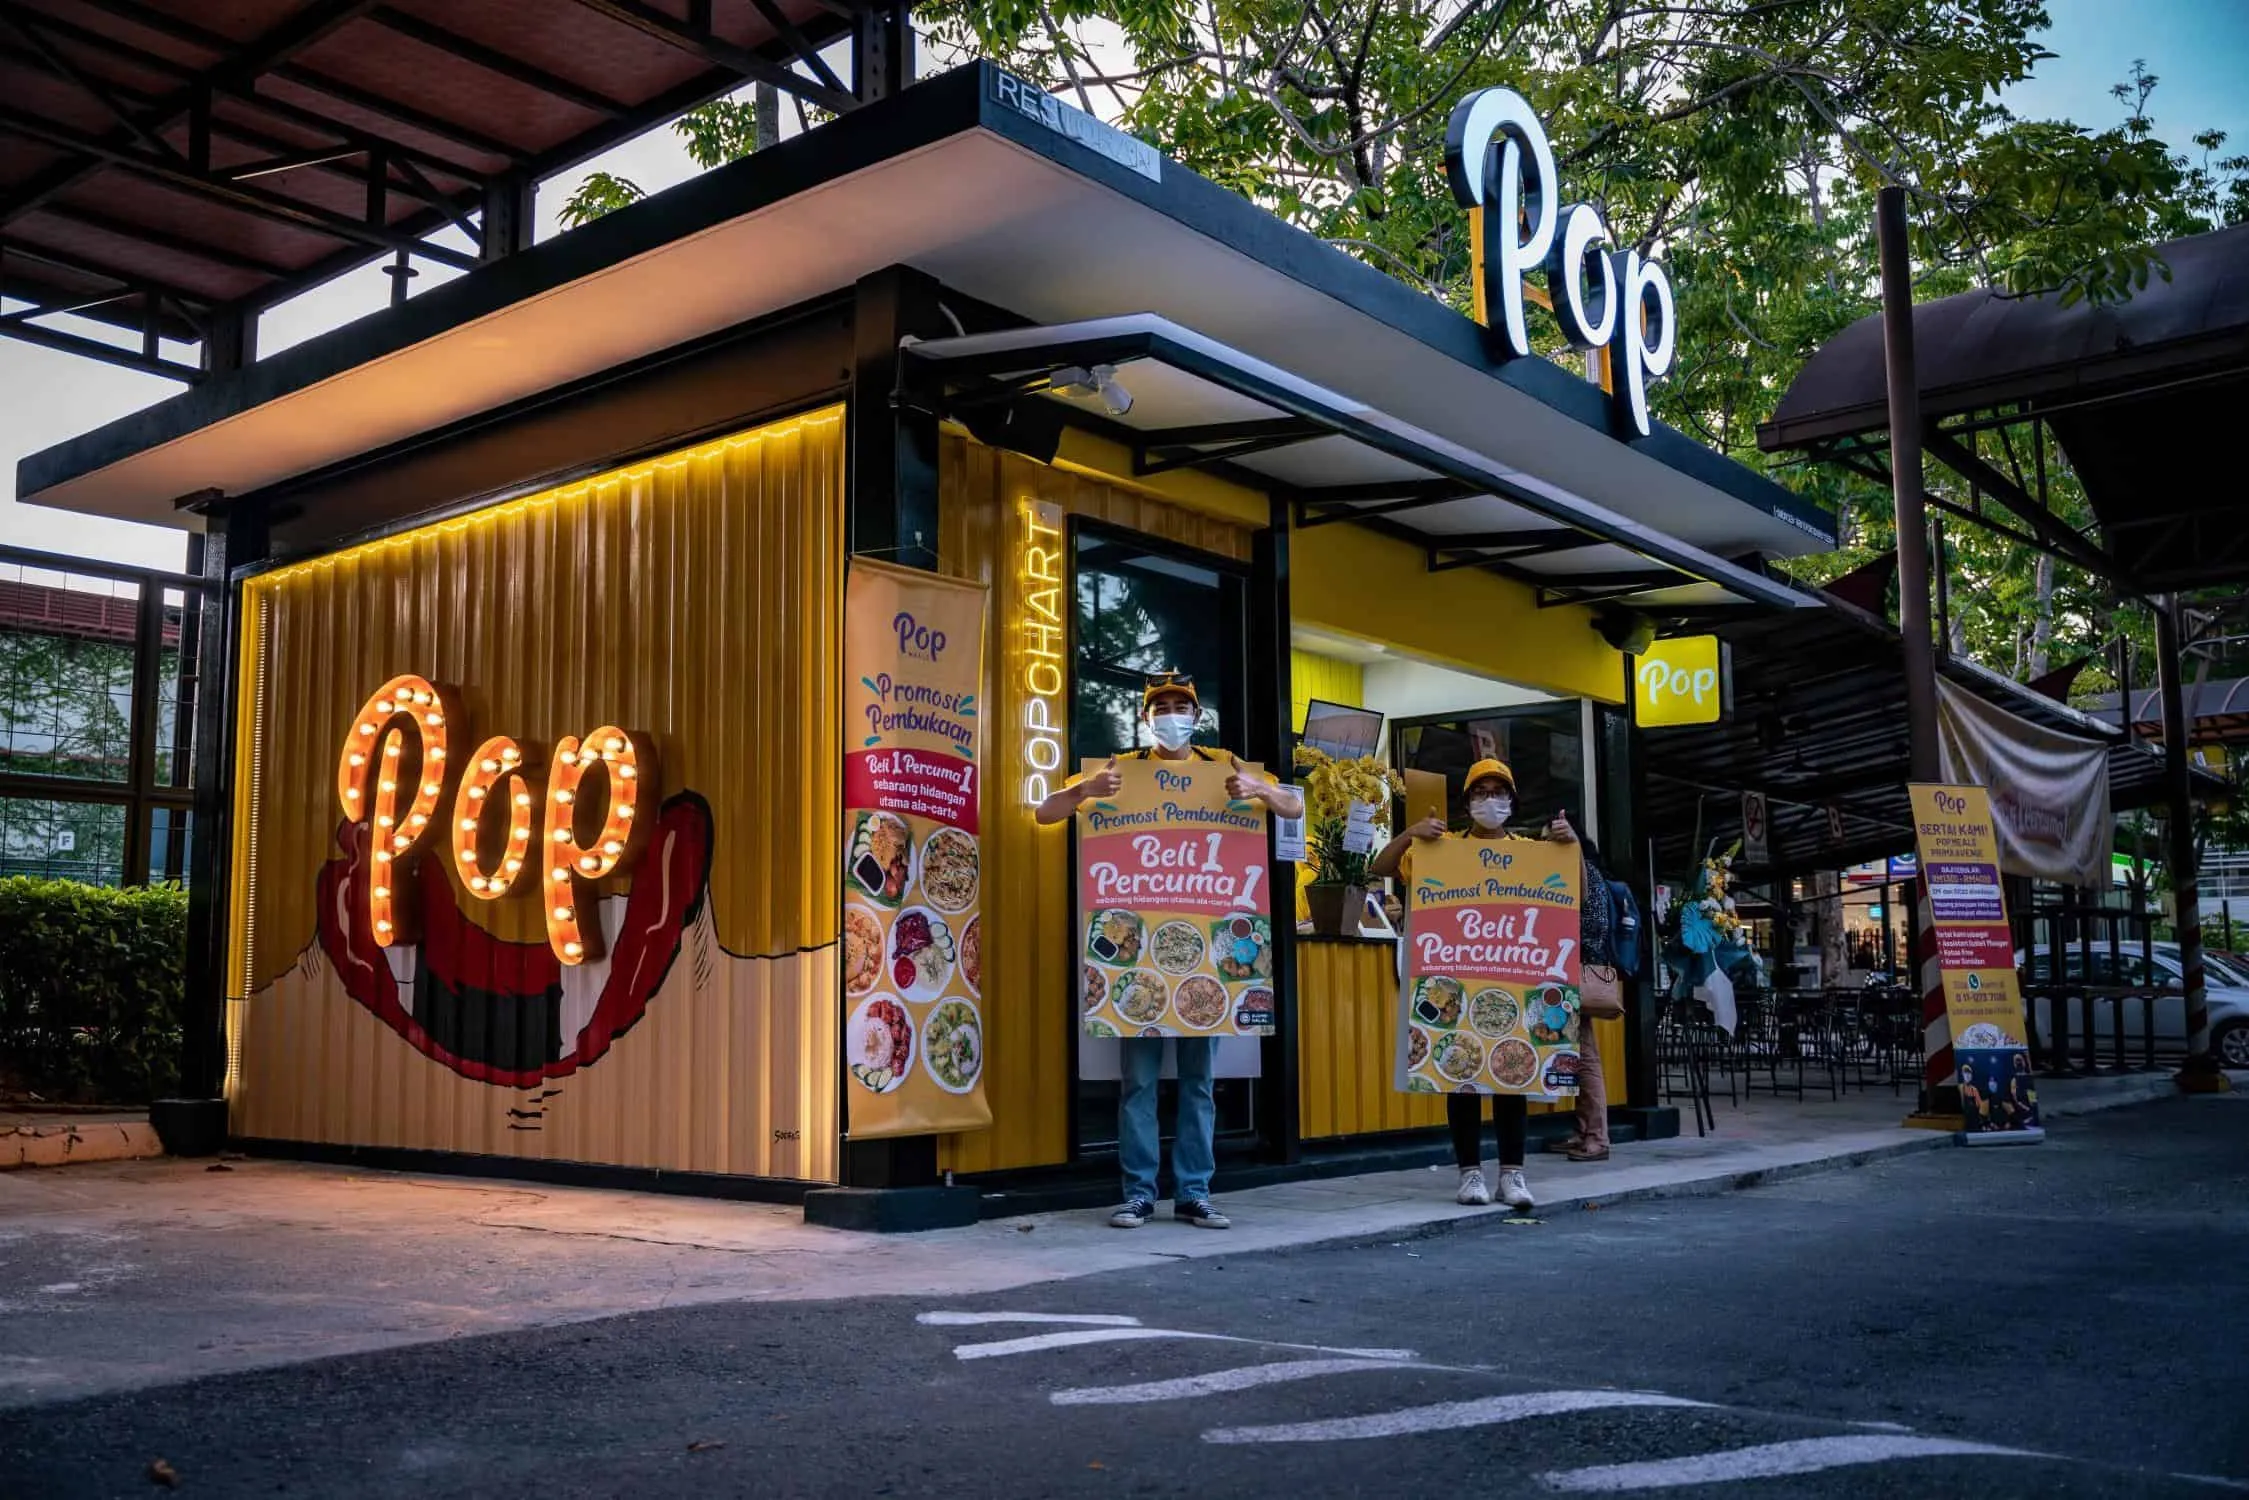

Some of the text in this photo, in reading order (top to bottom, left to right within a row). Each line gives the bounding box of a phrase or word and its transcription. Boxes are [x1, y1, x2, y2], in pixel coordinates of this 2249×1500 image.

[1447, 86, 1675, 437] Pop
[893, 611, 946, 662] Pop
[876, 672, 961, 713] Promosi
[1639, 659, 1715, 705] Pop
[865, 704, 973, 746] Pembukaan
[865, 751, 974, 794] Beli 1 Percuma 1
[873, 779, 966, 807] sebarang hidangan
[1154, 769, 1192, 793] Pop
[338, 673, 638, 965] Pop
[879, 796, 958, 819] utama ala-carte
[1088, 802, 1260, 831] Promosi Pembukaan
[1934, 791, 1966, 816] Pop
[62, 835, 71, 846] F
[1132, 832, 1224, 873] Beli 1
[1478, 847, 1513, 870] Pop
[1089, 861, 1263, 910] Percuma 1
[1417, 878, 1575, 905] Promosi Pembukaan
[1456, 907, 1539, 944] Beli 1
[1416, 932, 1576, 981] Percuma 1
